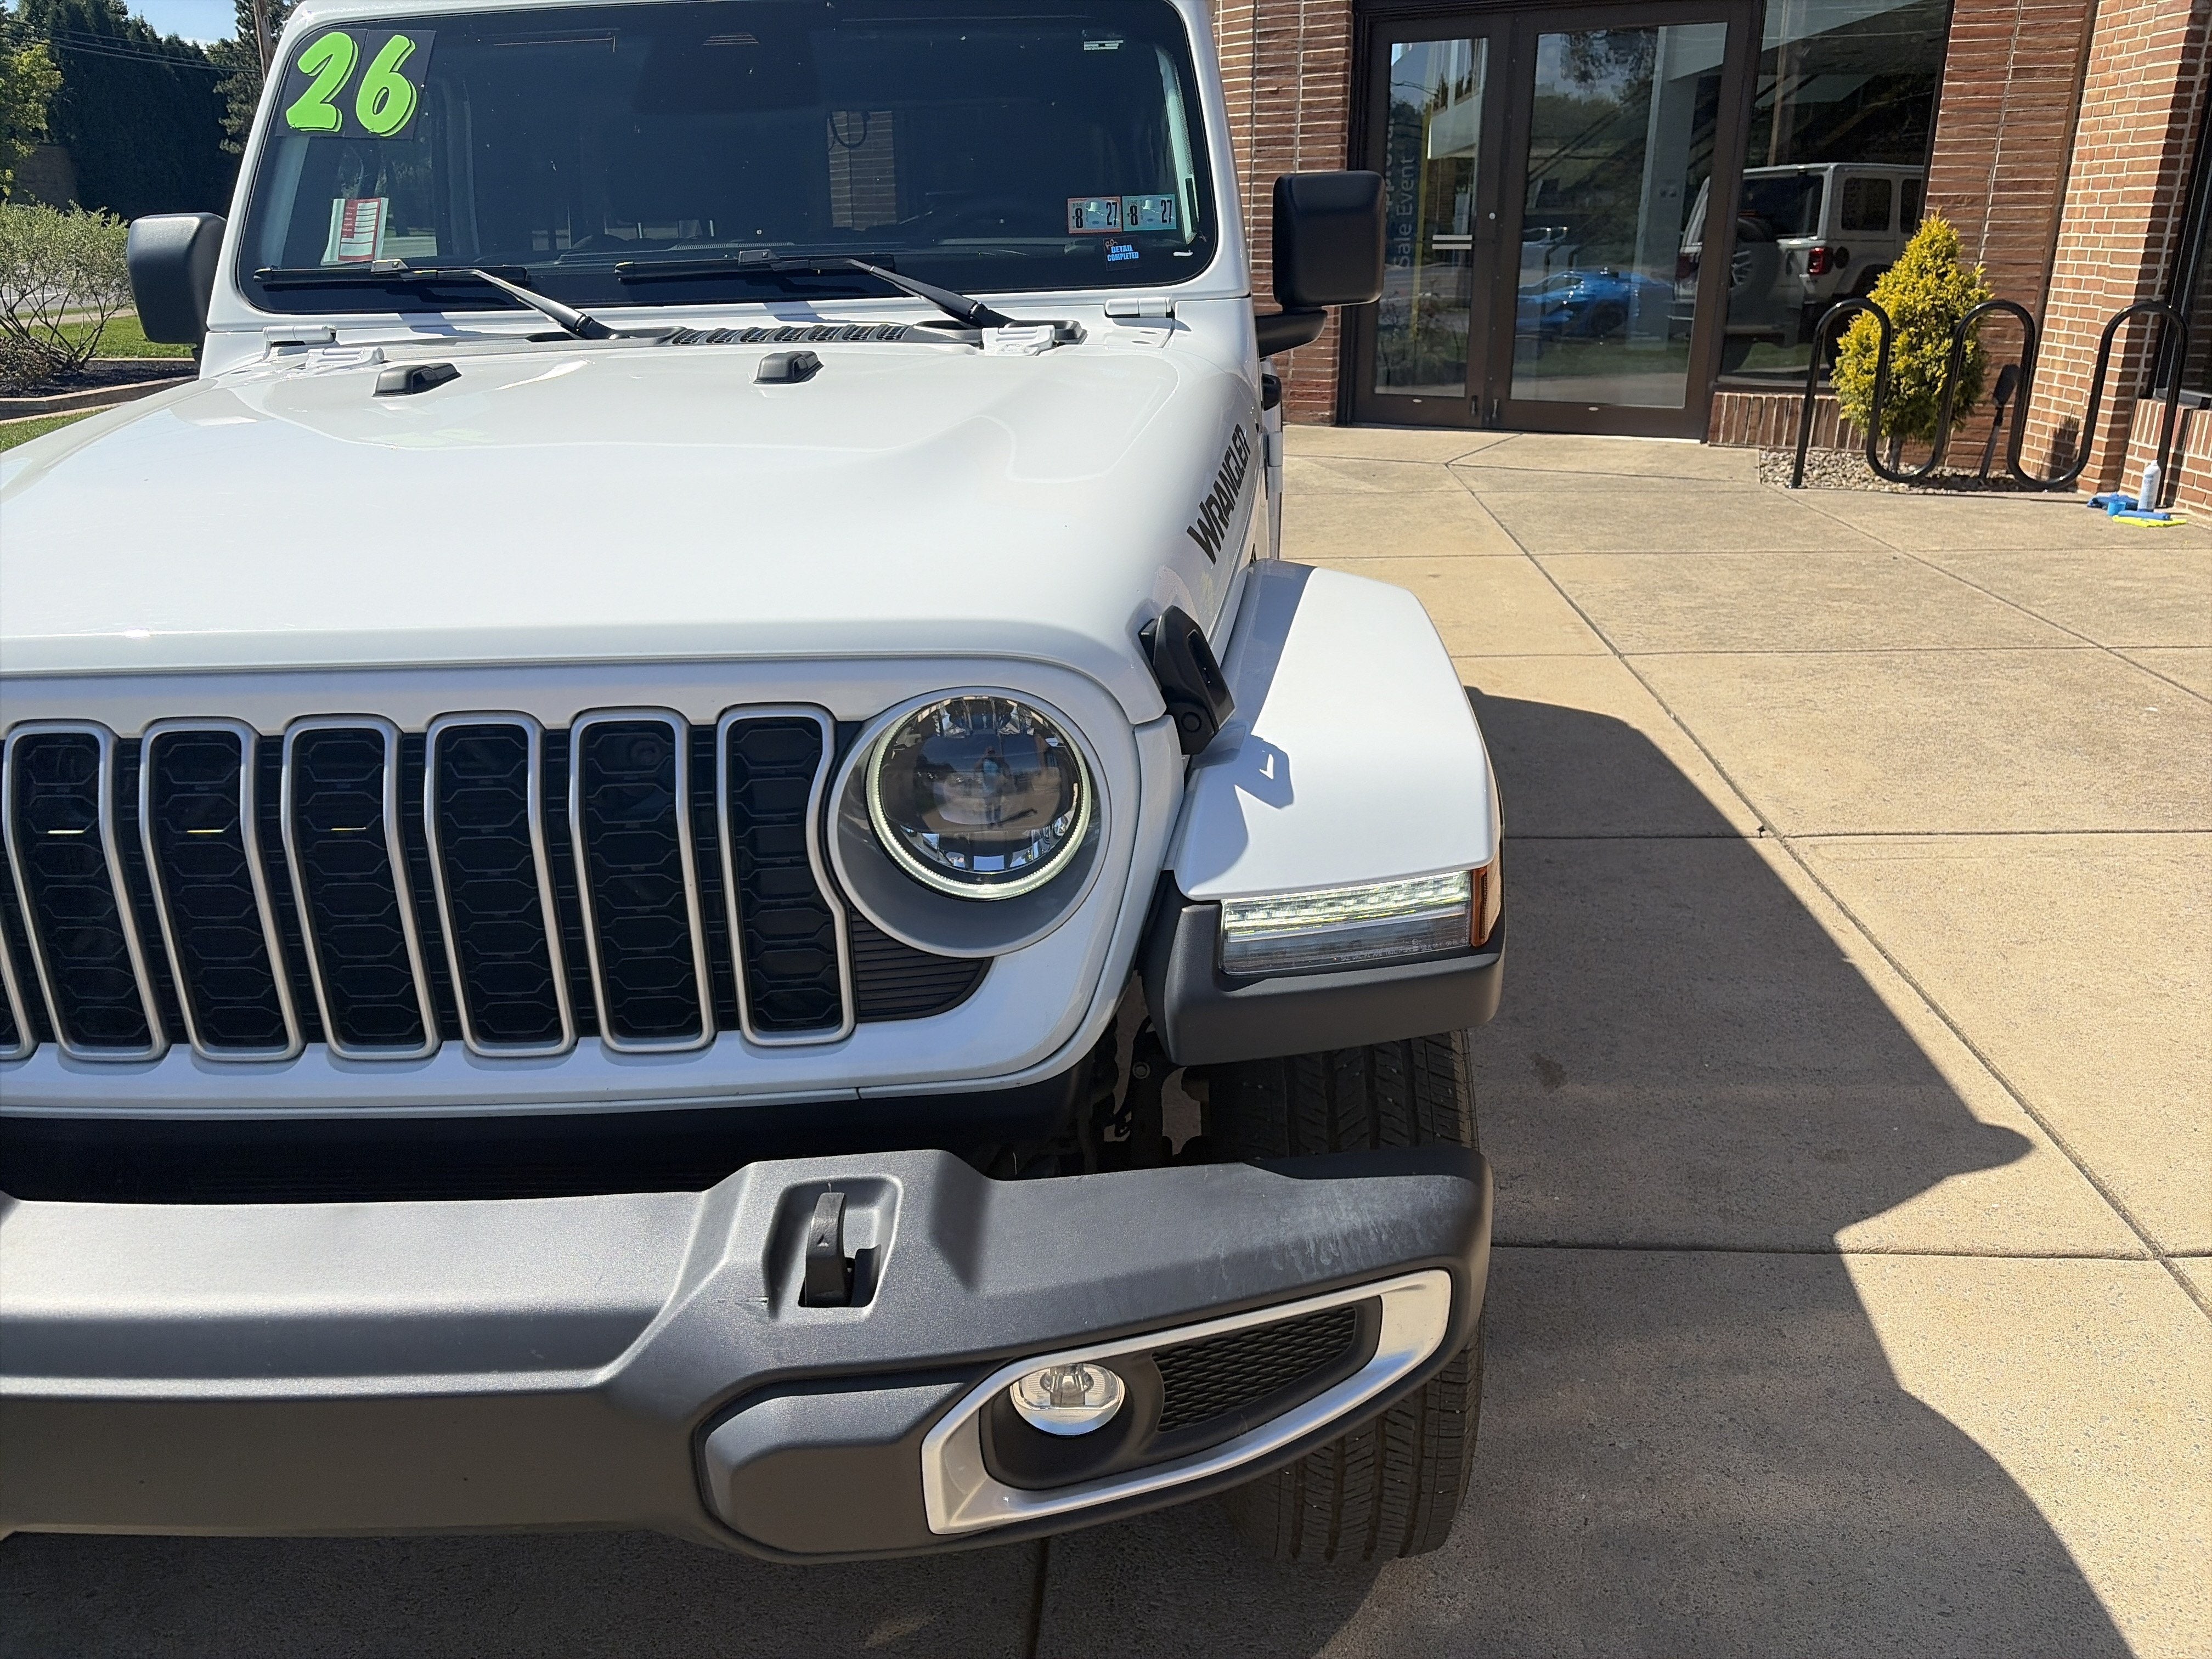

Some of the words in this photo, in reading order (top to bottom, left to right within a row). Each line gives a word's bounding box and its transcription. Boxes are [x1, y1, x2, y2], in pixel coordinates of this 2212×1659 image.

[285, 31, 419, 137] 26
[1396, 156, 1415, 216] Event
[1075, 207, 1084, 228] 8
[1106, 201, 1118, 227] 27
[1130, 205, 1138, 225] 8
[1160, 199, 1172, 224] 27
[1107, 252, 1139, 261] COMPLETED
[1111, 244, 1133, 253] DETAIL
[1393, 223, 1413, 267] Sale
[1186, 424, 1251, 566] WRANGLER
